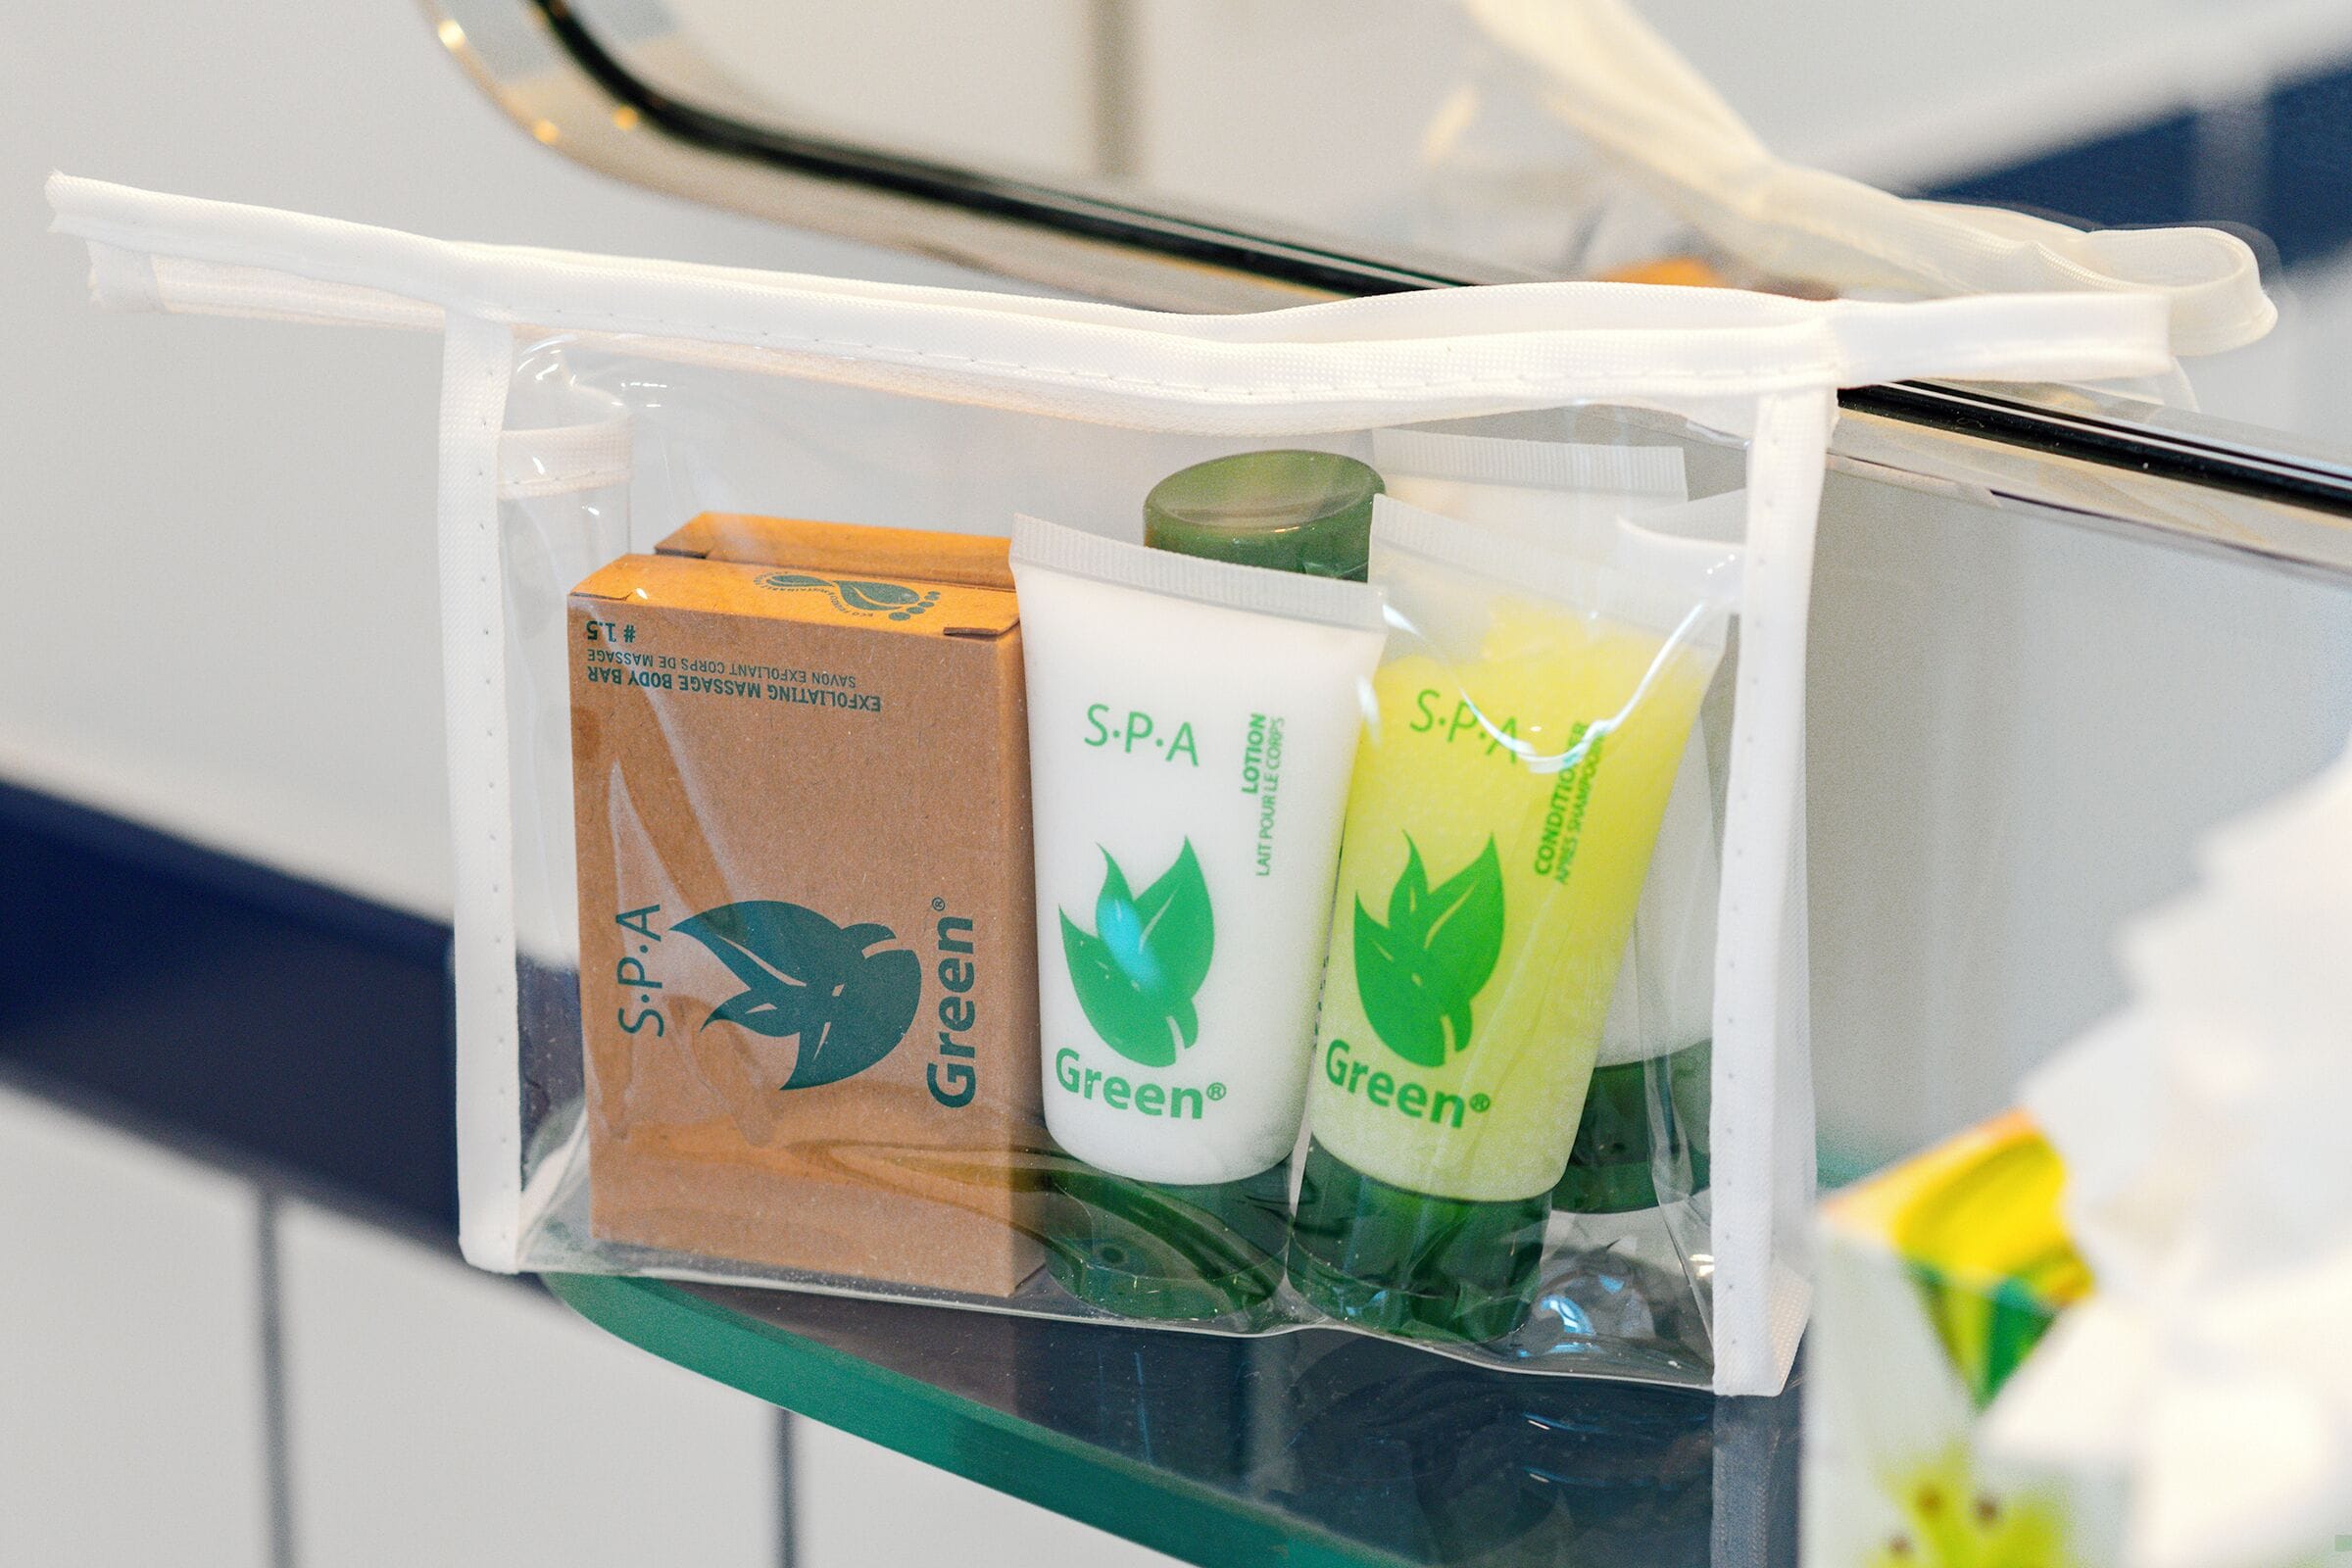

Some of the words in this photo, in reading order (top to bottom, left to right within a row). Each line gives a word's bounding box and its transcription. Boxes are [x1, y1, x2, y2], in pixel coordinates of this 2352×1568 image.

[586, 620, 616, 643] 1.5
[622, 624, 636, 643] #
[586, 649, 654, 667] MASSAGE
[659, 656, 676, 669] DE
[681, 658, 725, 675] CORPS
[587, 666, 622, 685] BAR
[628, 670, 673, 690] BODY
[729, 662, 807, 684] EXFOLIANT
[811, 671, 857, 689] SAVON
[678, 674, 761, 699] MASSAGE
[767, 683, 881, 712] EXFOLIATING
[1240, 712, 1267, 794] LOTION
[1266, 716, 1286, 770] CORPS
[1263, 772, 1280, 792] LE
[1259, 795, 1276, 839] POUR
[1255, 844, 1271, 876] LAIT
